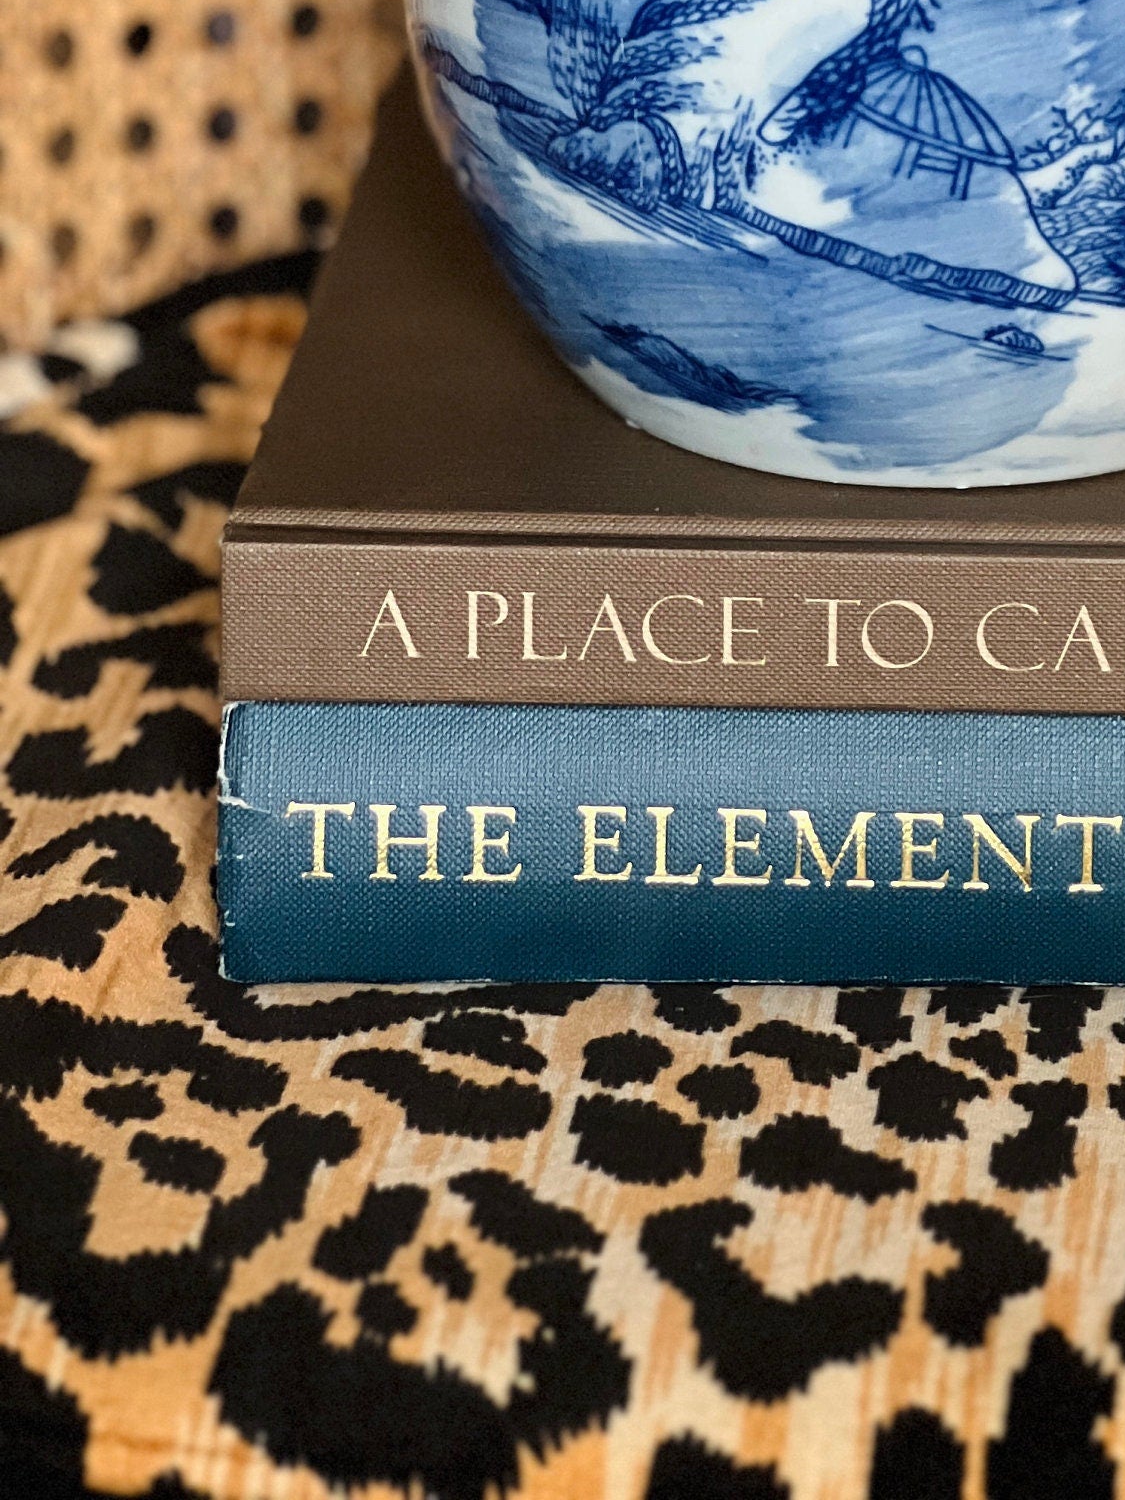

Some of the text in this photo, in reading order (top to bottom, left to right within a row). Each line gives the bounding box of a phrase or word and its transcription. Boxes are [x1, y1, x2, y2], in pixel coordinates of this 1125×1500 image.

[359, 588, 421, 659] A
[465, 590, 767, 667] PLACE
[803, 597, 935, 670] TO
[285, 801, 524, 883] THE
